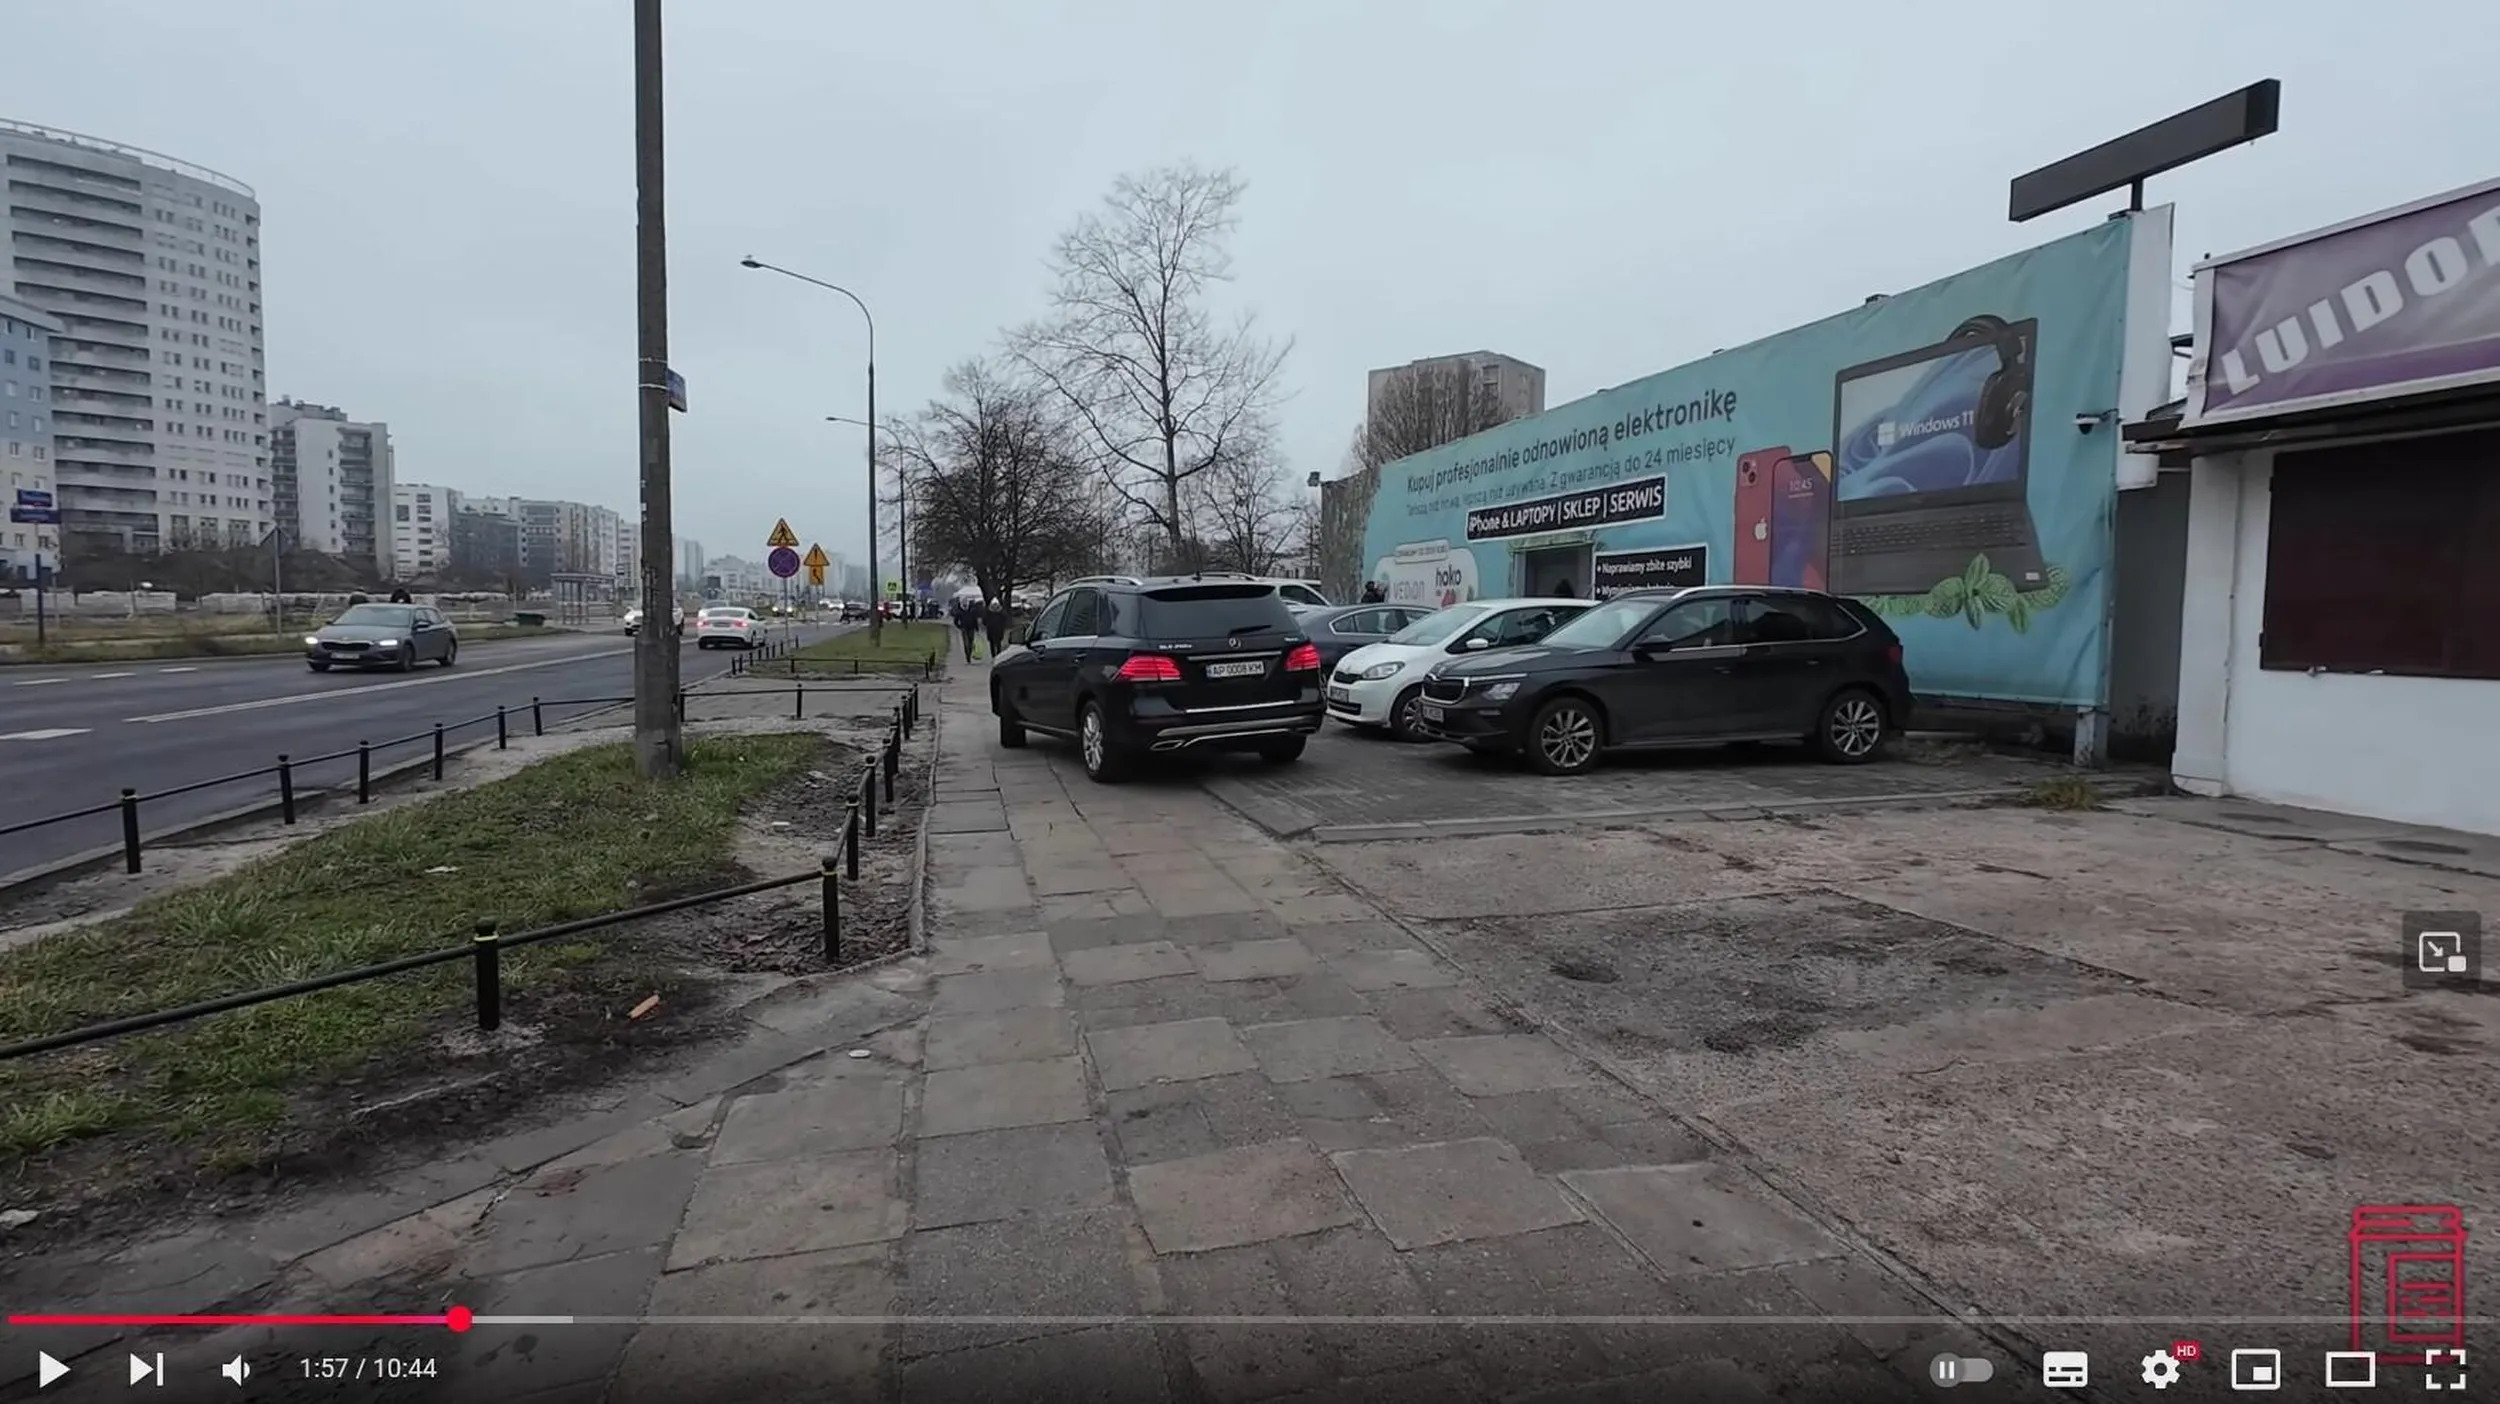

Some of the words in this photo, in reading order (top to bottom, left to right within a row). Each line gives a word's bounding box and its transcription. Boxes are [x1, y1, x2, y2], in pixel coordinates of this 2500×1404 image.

[1407, 469, 1435, 494] Kupuj
[1436, 452, 1519, 489] profesjonalnie
[1523, 426, 1608, 462] odnowioną
[1614, 388, 1737, 442] elektronikę
[1900, 413, 1961, 438] Windows
[1961, 409, 1974, 428] 11
[1560, 458, 1621, 490] gwarancją
[1624, 454, 1641, 473] do
[1644, 447, 1662, 469] 24
[1667, 436, 1736, 466] miesięcy
[1469, 514, 1500, 533] iPhone
[1501, 513, 1510, 528] &
[1510, 504, 1556, 528] LAPTOPY
[1563, 497, 1600, 521] SKLEP
[1610, 486, 1662, 513] SERWIS
[1435, 563, 1463, 588] hoko
[1602, 560, 1646, 575] Naprawiamy
[1666, 555, 1693, 573] szybki
